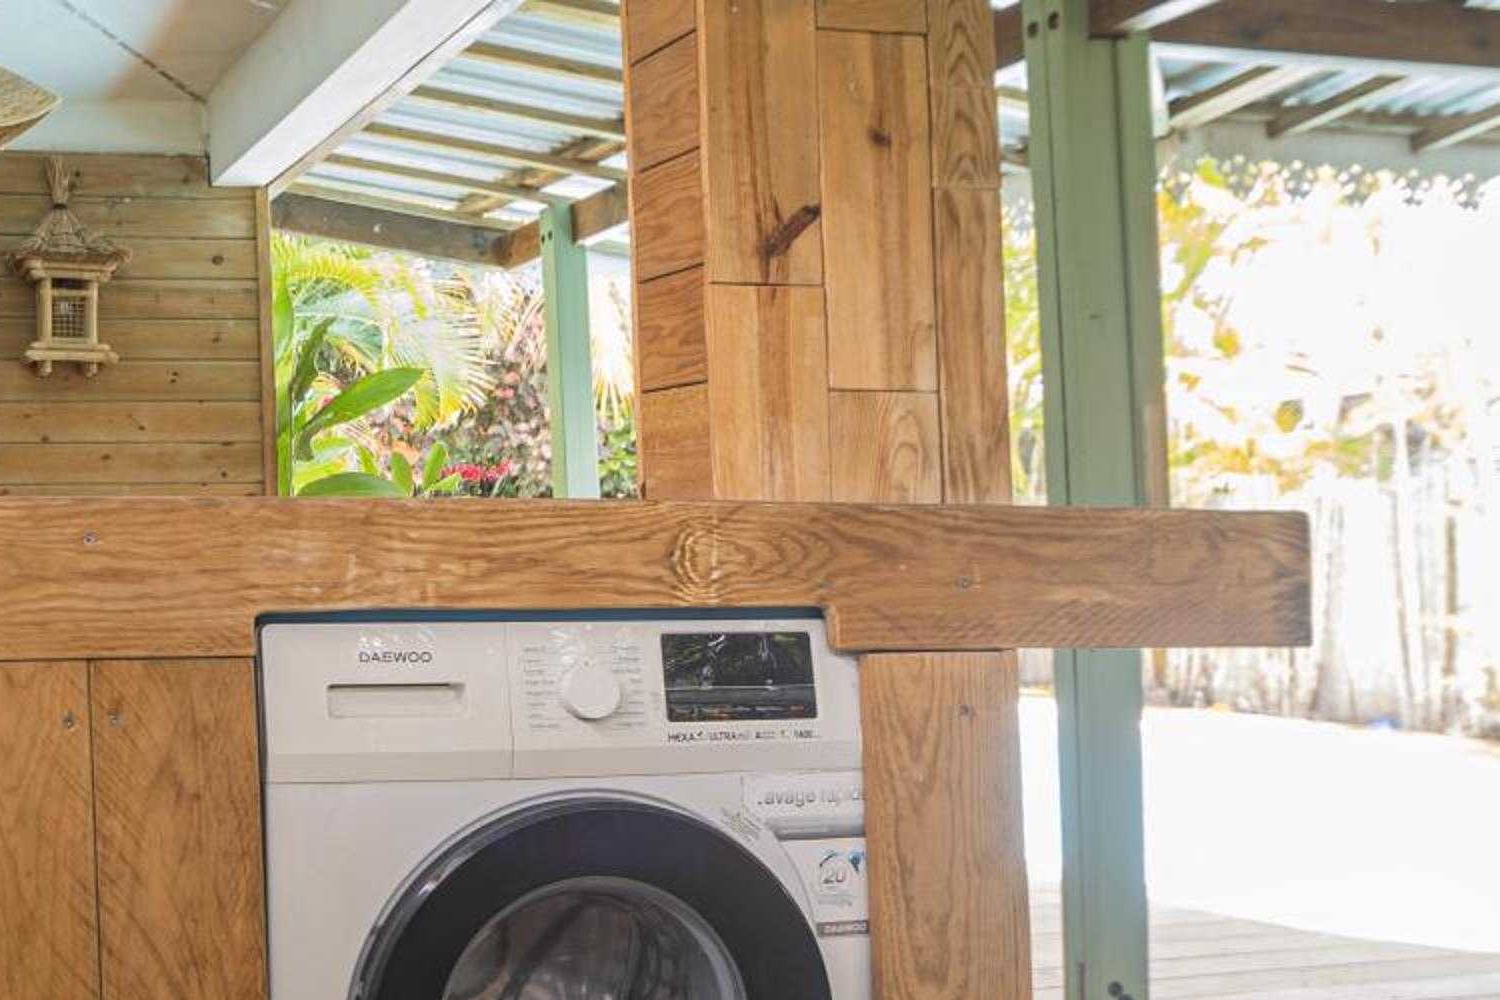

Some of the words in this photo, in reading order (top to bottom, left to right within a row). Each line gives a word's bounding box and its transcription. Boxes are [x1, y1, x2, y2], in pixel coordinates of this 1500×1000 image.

[358, 651, 433, 664] DAEWOO
[756, 787, 817, 807] avage
[823, 867, 847, 884] 20
